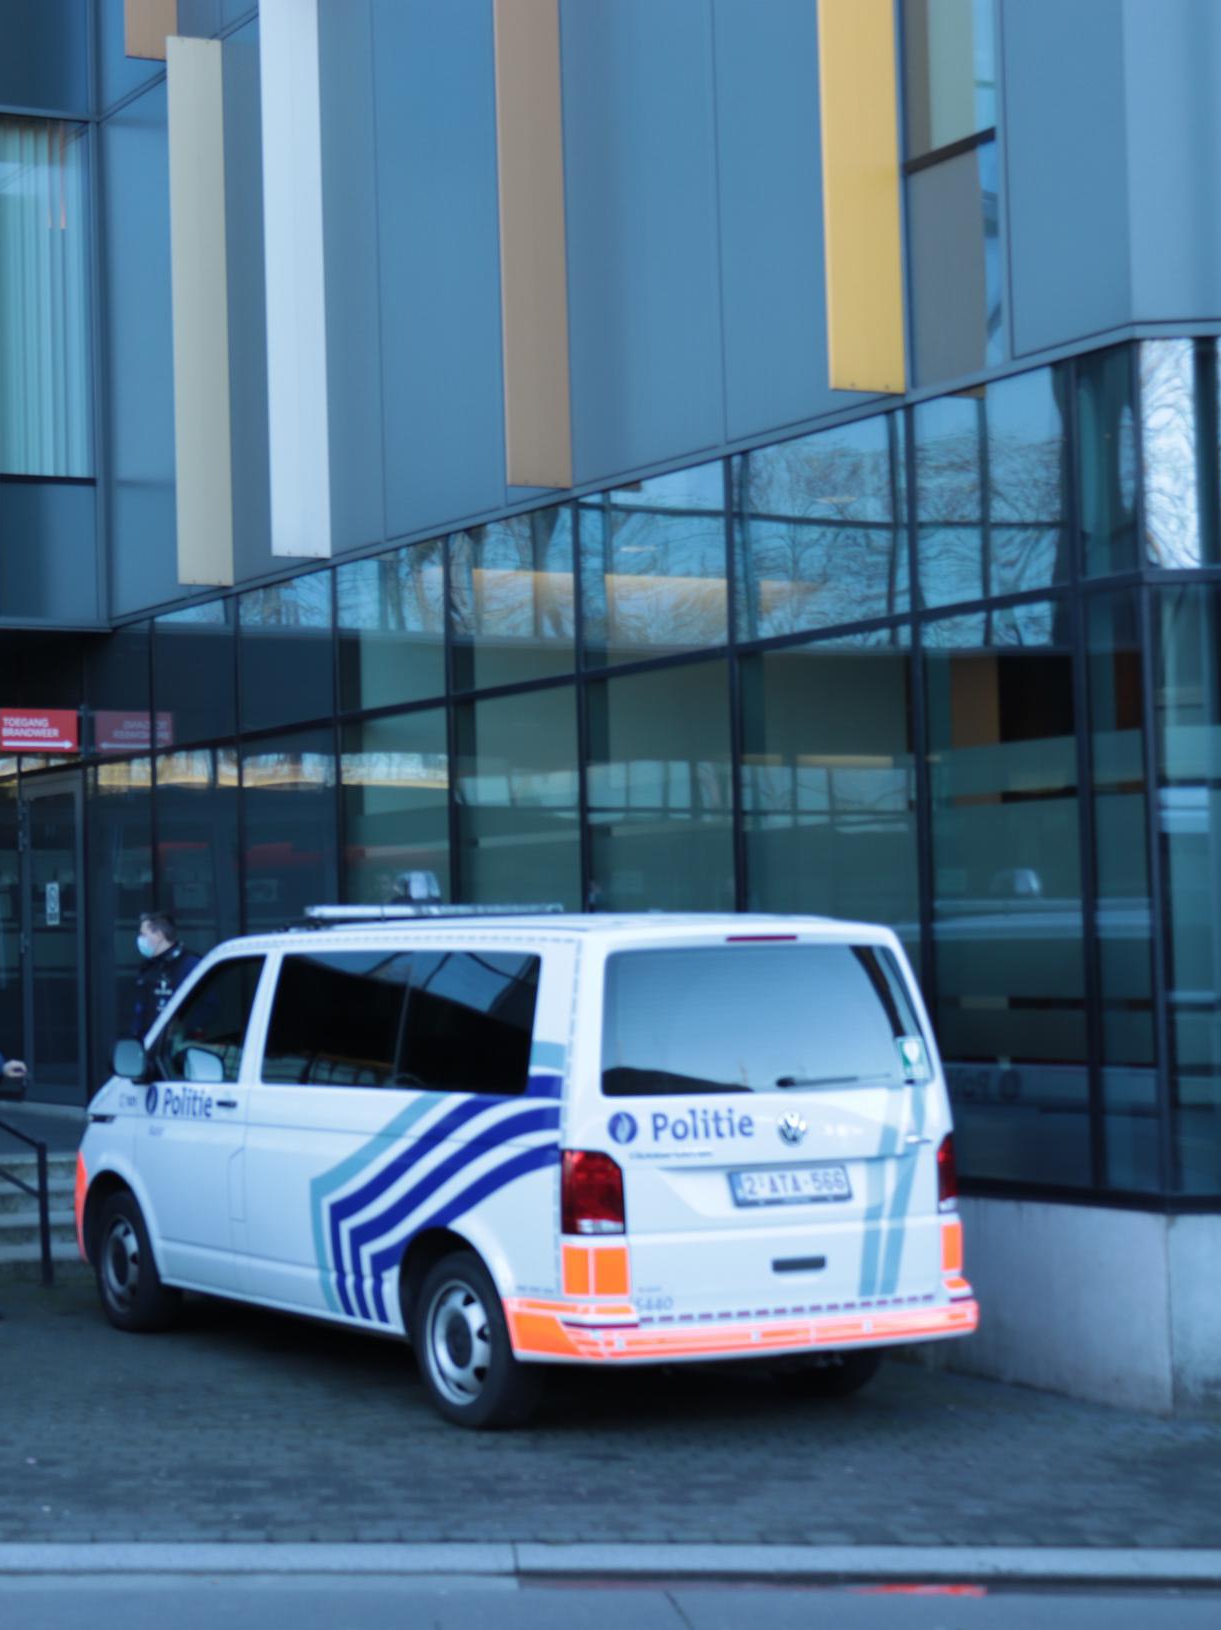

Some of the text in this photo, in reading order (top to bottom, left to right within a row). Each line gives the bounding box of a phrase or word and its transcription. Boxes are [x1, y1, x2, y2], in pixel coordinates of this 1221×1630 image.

[2, 716, 49, 728] TOEGANG
[2, 727, 60, 738] BRANDWEER
[164, 1087, 213, 1117] Politie
[652, 1107, 755, 1142] Politie
